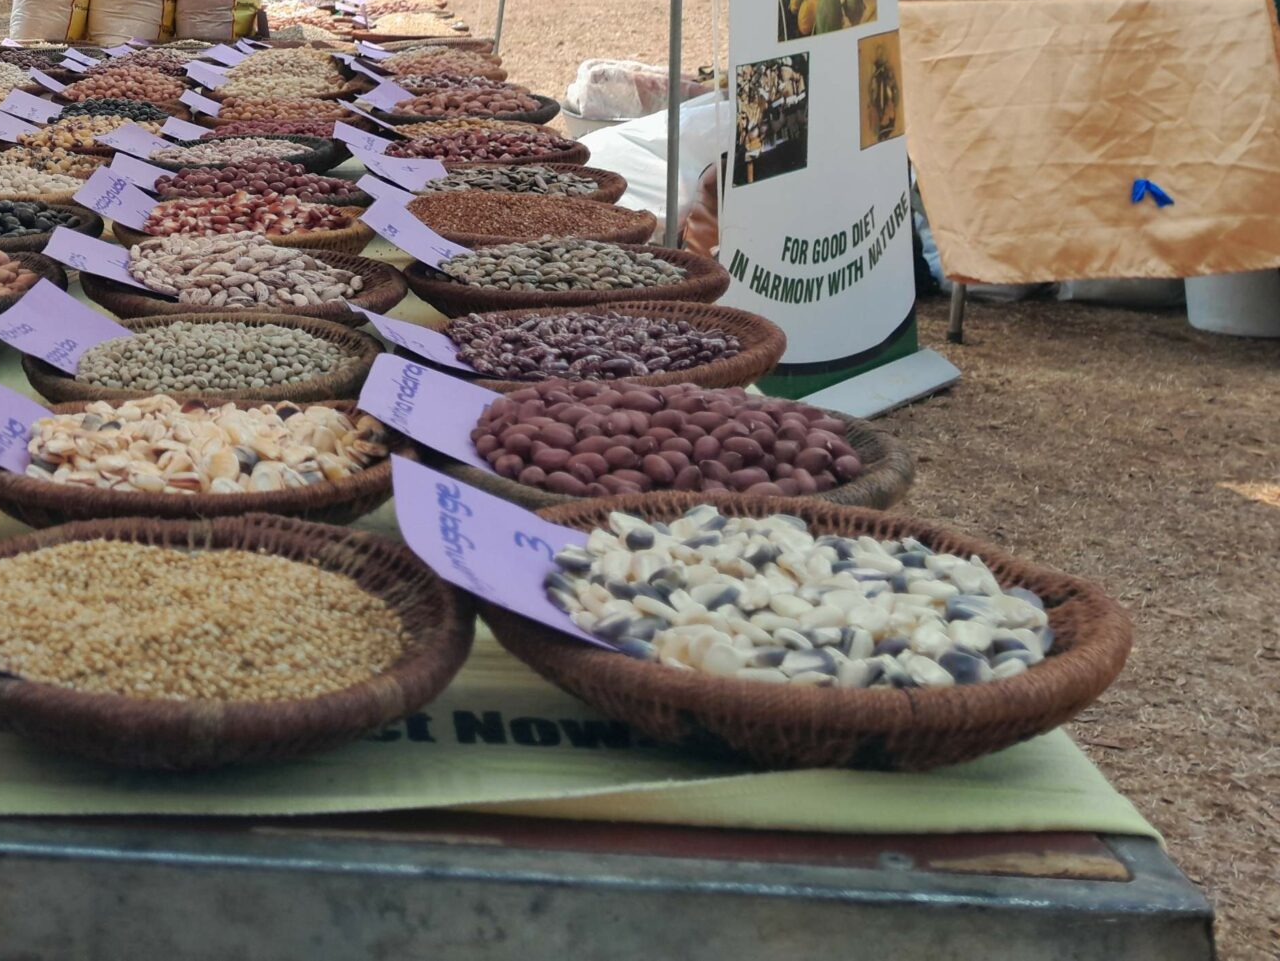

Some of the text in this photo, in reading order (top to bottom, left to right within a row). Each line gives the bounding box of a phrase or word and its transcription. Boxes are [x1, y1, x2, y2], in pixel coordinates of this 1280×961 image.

[728, 190, 910, 305] IN HARMONY WITH NATURE
[781, 205, 875, 265] FOR GOOD DIET
